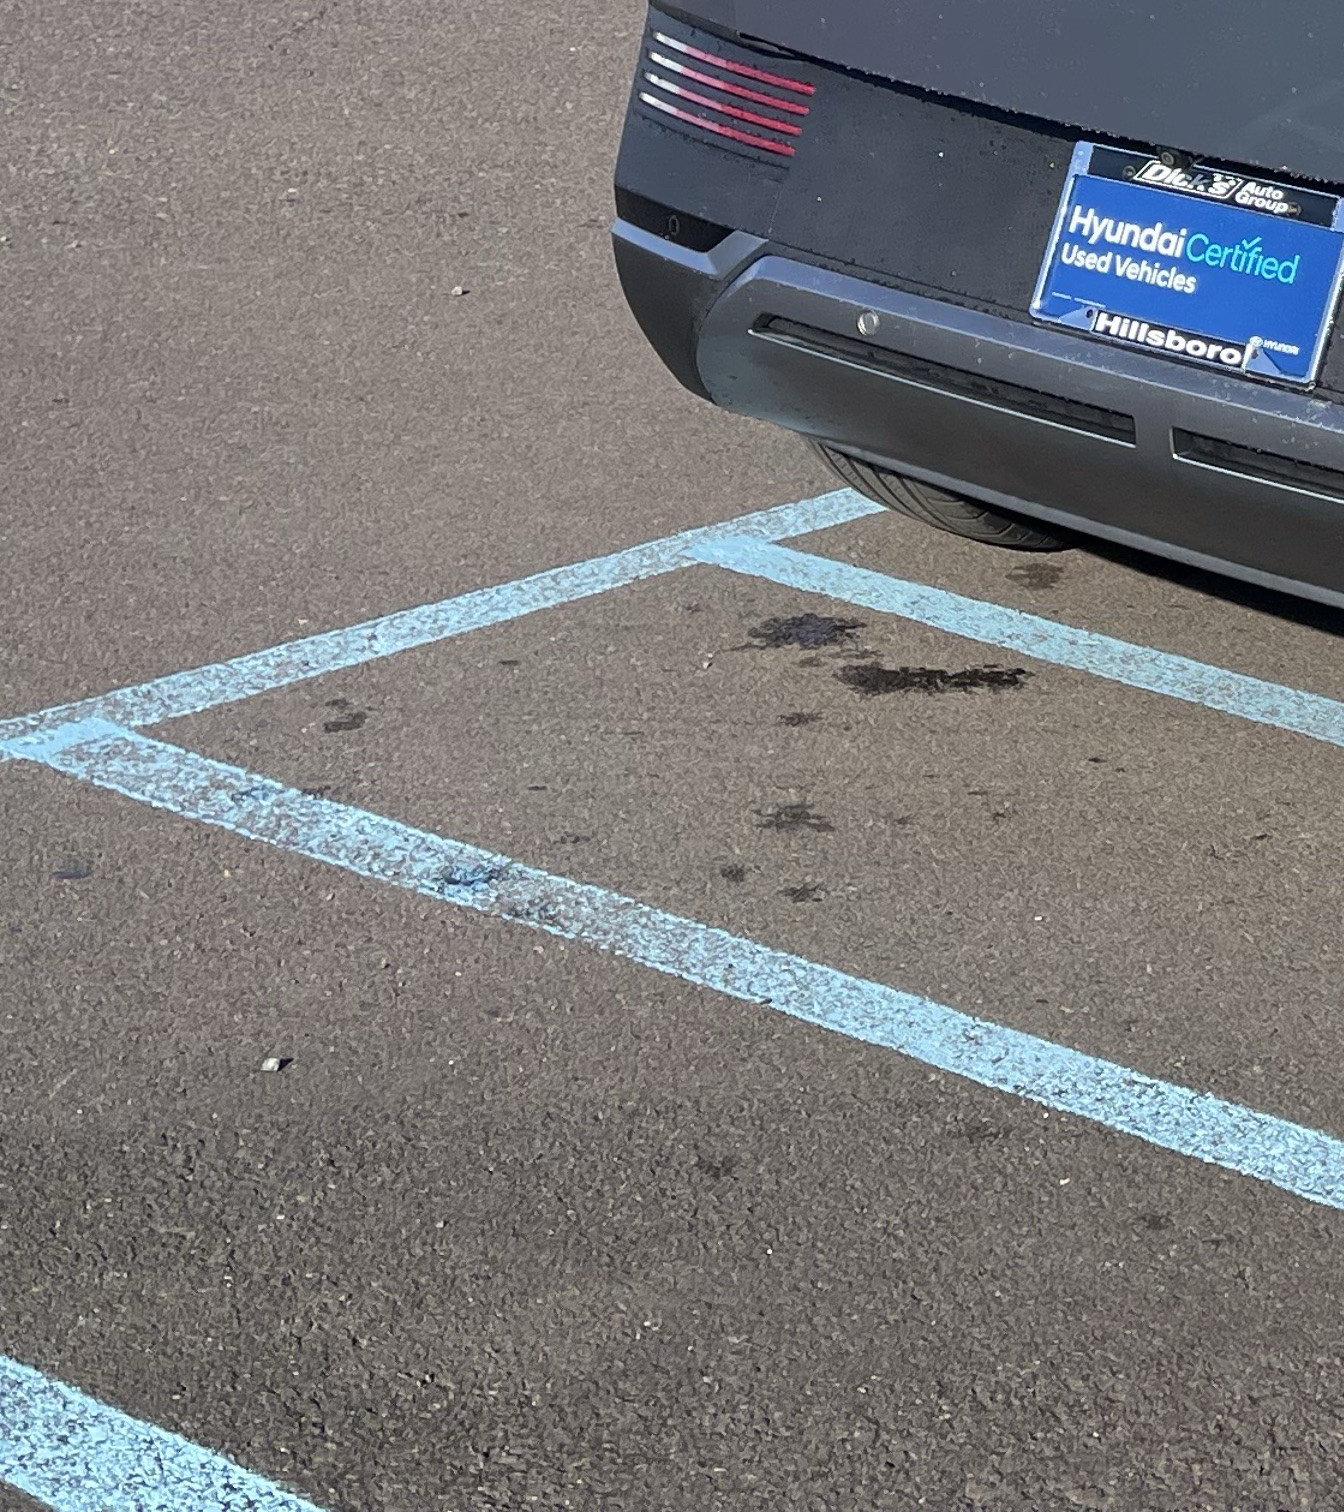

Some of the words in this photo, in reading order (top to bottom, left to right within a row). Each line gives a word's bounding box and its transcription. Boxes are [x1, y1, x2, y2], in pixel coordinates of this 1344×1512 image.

[1235, 191, 1290, 214] Group
[1240, 181, 1284, 201] Auto
[1061, 242, 1114, 273] Used
[1115, 254, 1198, 295] Vehicles
[1068, 204, 1187, 258] Hyundai
[1186, 233, 1301, 284] Certified
[1094, 312, 1243, 366] Hillsboro
